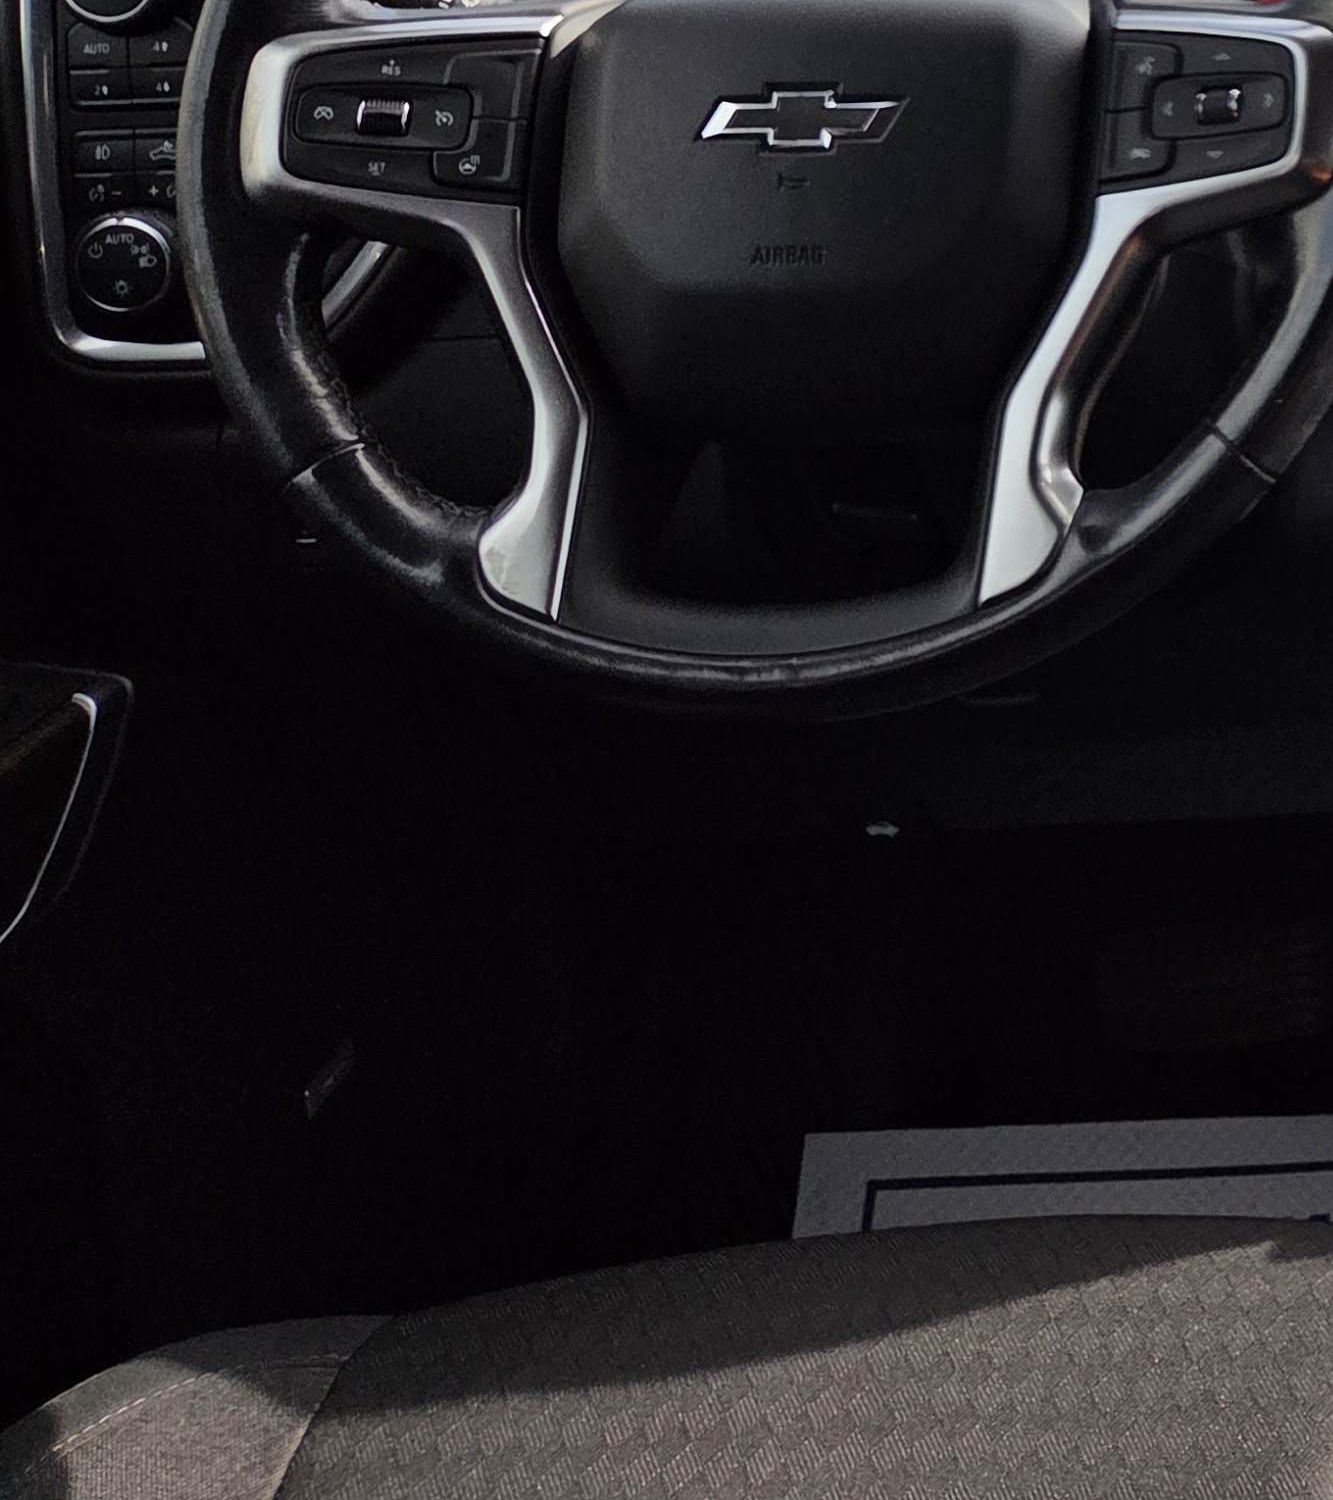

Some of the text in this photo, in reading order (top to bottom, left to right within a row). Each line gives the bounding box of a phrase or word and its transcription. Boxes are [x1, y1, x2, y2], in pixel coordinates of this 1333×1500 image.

[83, 43, 110, 55] AUTO
[105, 233, 134, 245] AUTO
[750, 245, 824, 265] AIRBAG
